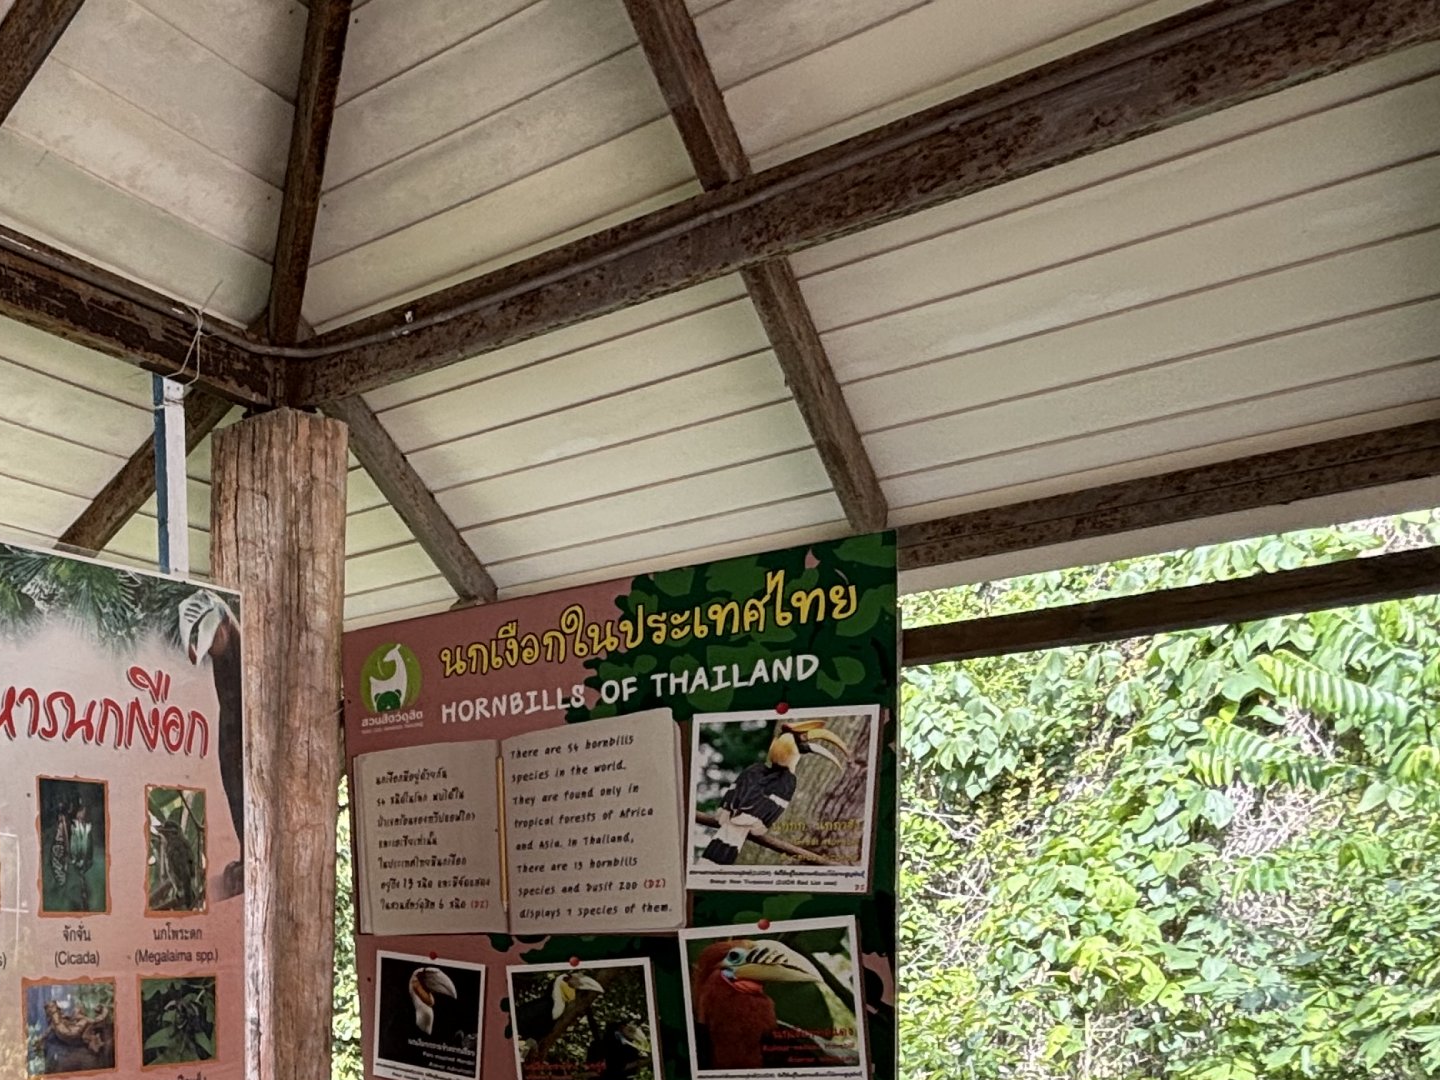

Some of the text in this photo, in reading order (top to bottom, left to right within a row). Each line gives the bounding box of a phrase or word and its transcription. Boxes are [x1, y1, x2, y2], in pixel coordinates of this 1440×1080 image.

[439, 569, 858, 678] นกเงือกในประเทศไทย
[441, 654, 820, 724] HORNBILLS OF THAILAND
[511, 744, 538, 759] There
[544, 744, 561, 755] are
[585, 735, 634, 750] hornbills
[512, 770, 549, 784] species
[555, 767, 565, 777] in
[570, 763, 588, 776] the
[513, 783, 639, 807] They are found only in
[514, 806, 654, 829] tropical forests of Africa
[516, 839, 533, 851] and
[517, 861, 545, 873] There
[551, 861, 568, 871] are
[589, 856, 638, 869] hornbills
[518, 884, 555, 898] species
[561, 882, 580, 894] and
[578, 904, 618, 918] species
[624, 902, 635, 914] of
[54, 951, 100, 967] (Cicada)
